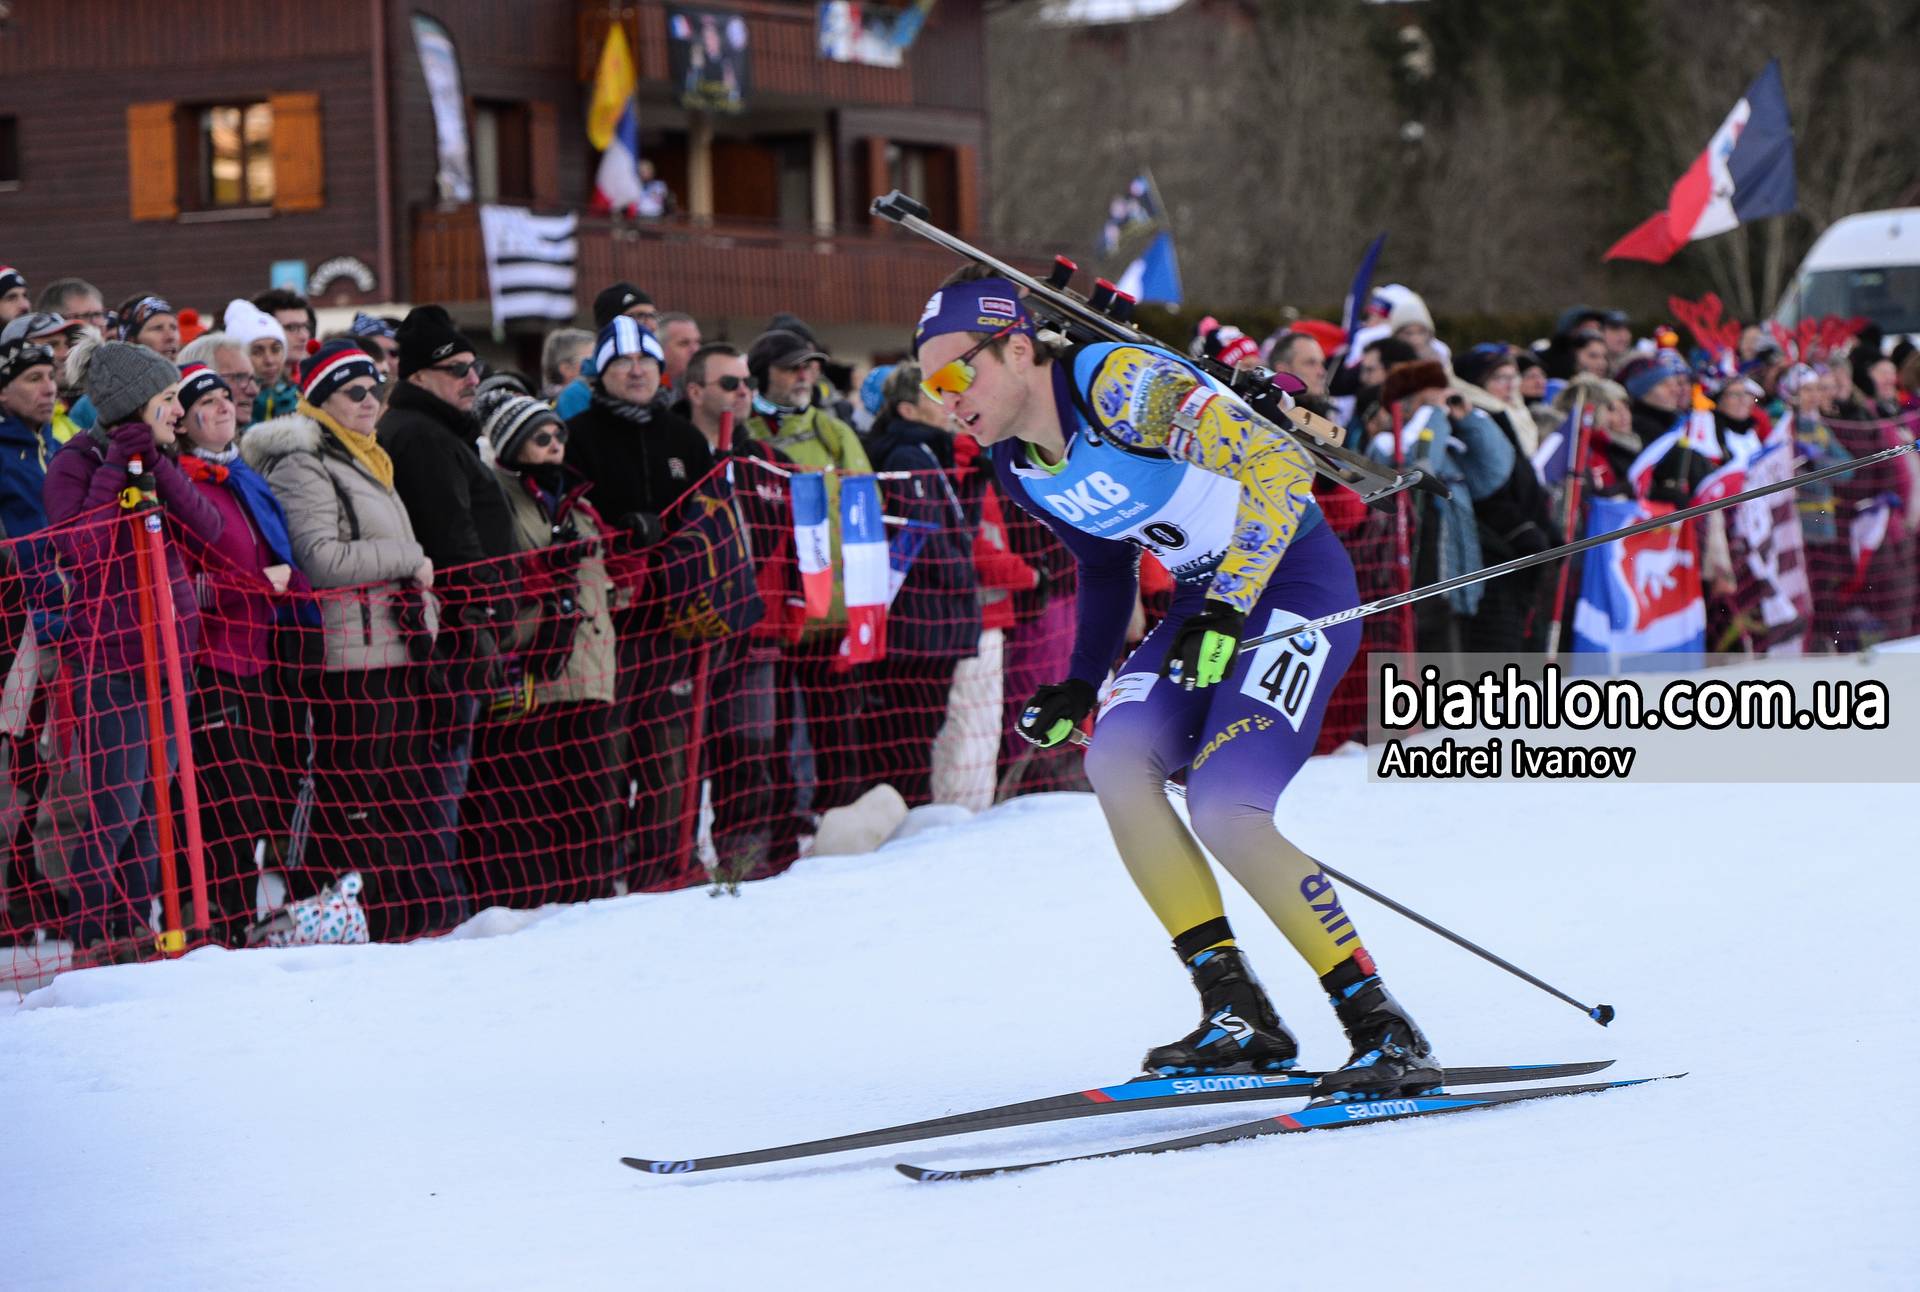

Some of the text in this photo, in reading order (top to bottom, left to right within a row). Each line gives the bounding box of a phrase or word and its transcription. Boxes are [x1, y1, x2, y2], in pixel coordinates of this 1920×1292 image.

[1043, 471, 1131, 522] DKB
[1259, 650, 1310, 717] 40
[1192, 718, 1251, 770] CRAFT
[1299, 871, 1358, 947] UKR
[1172, 1075, 1264, 1095] salomon
[1344, 1100, 1419, 1119] salomon
